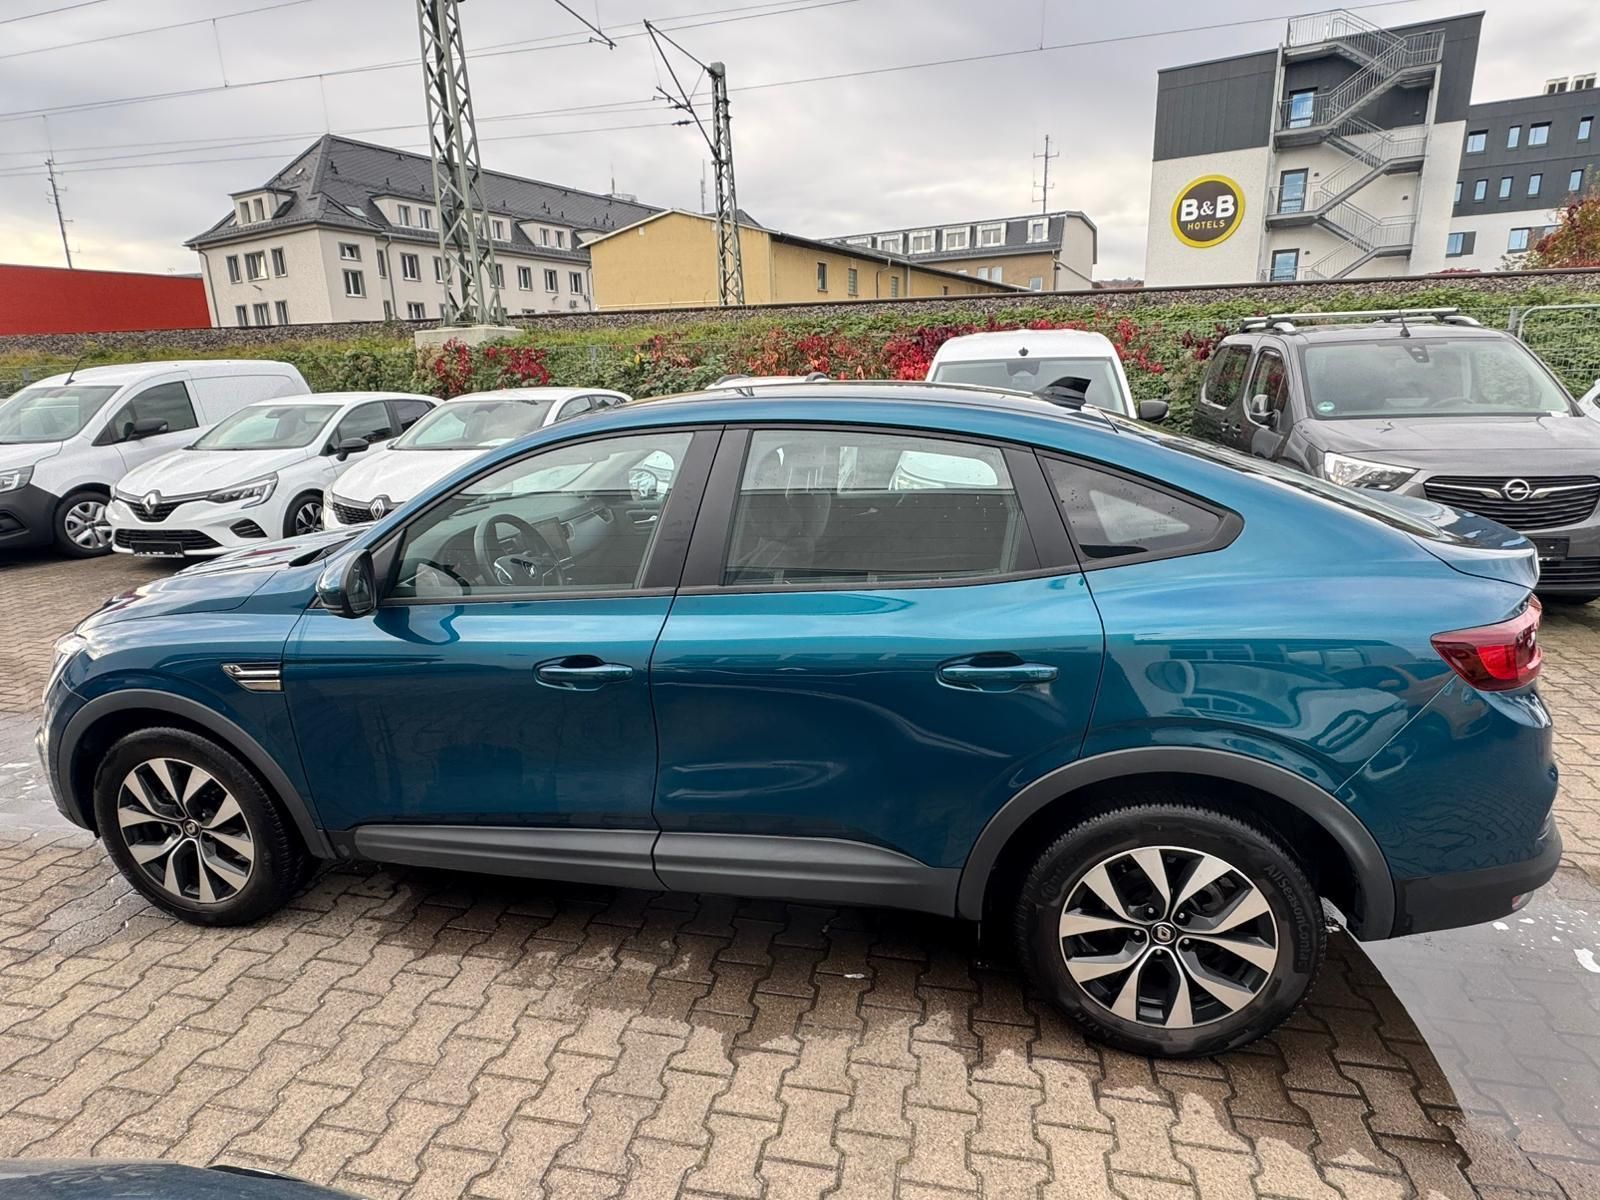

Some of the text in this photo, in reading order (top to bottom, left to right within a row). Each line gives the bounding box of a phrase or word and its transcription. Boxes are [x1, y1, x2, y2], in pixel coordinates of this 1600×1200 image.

[1181, 194, 1235, 221] B&B
[1187, 219, 1226, 231] HOTELS
[1263, 863, 1311, 971] AllSeasonContac
